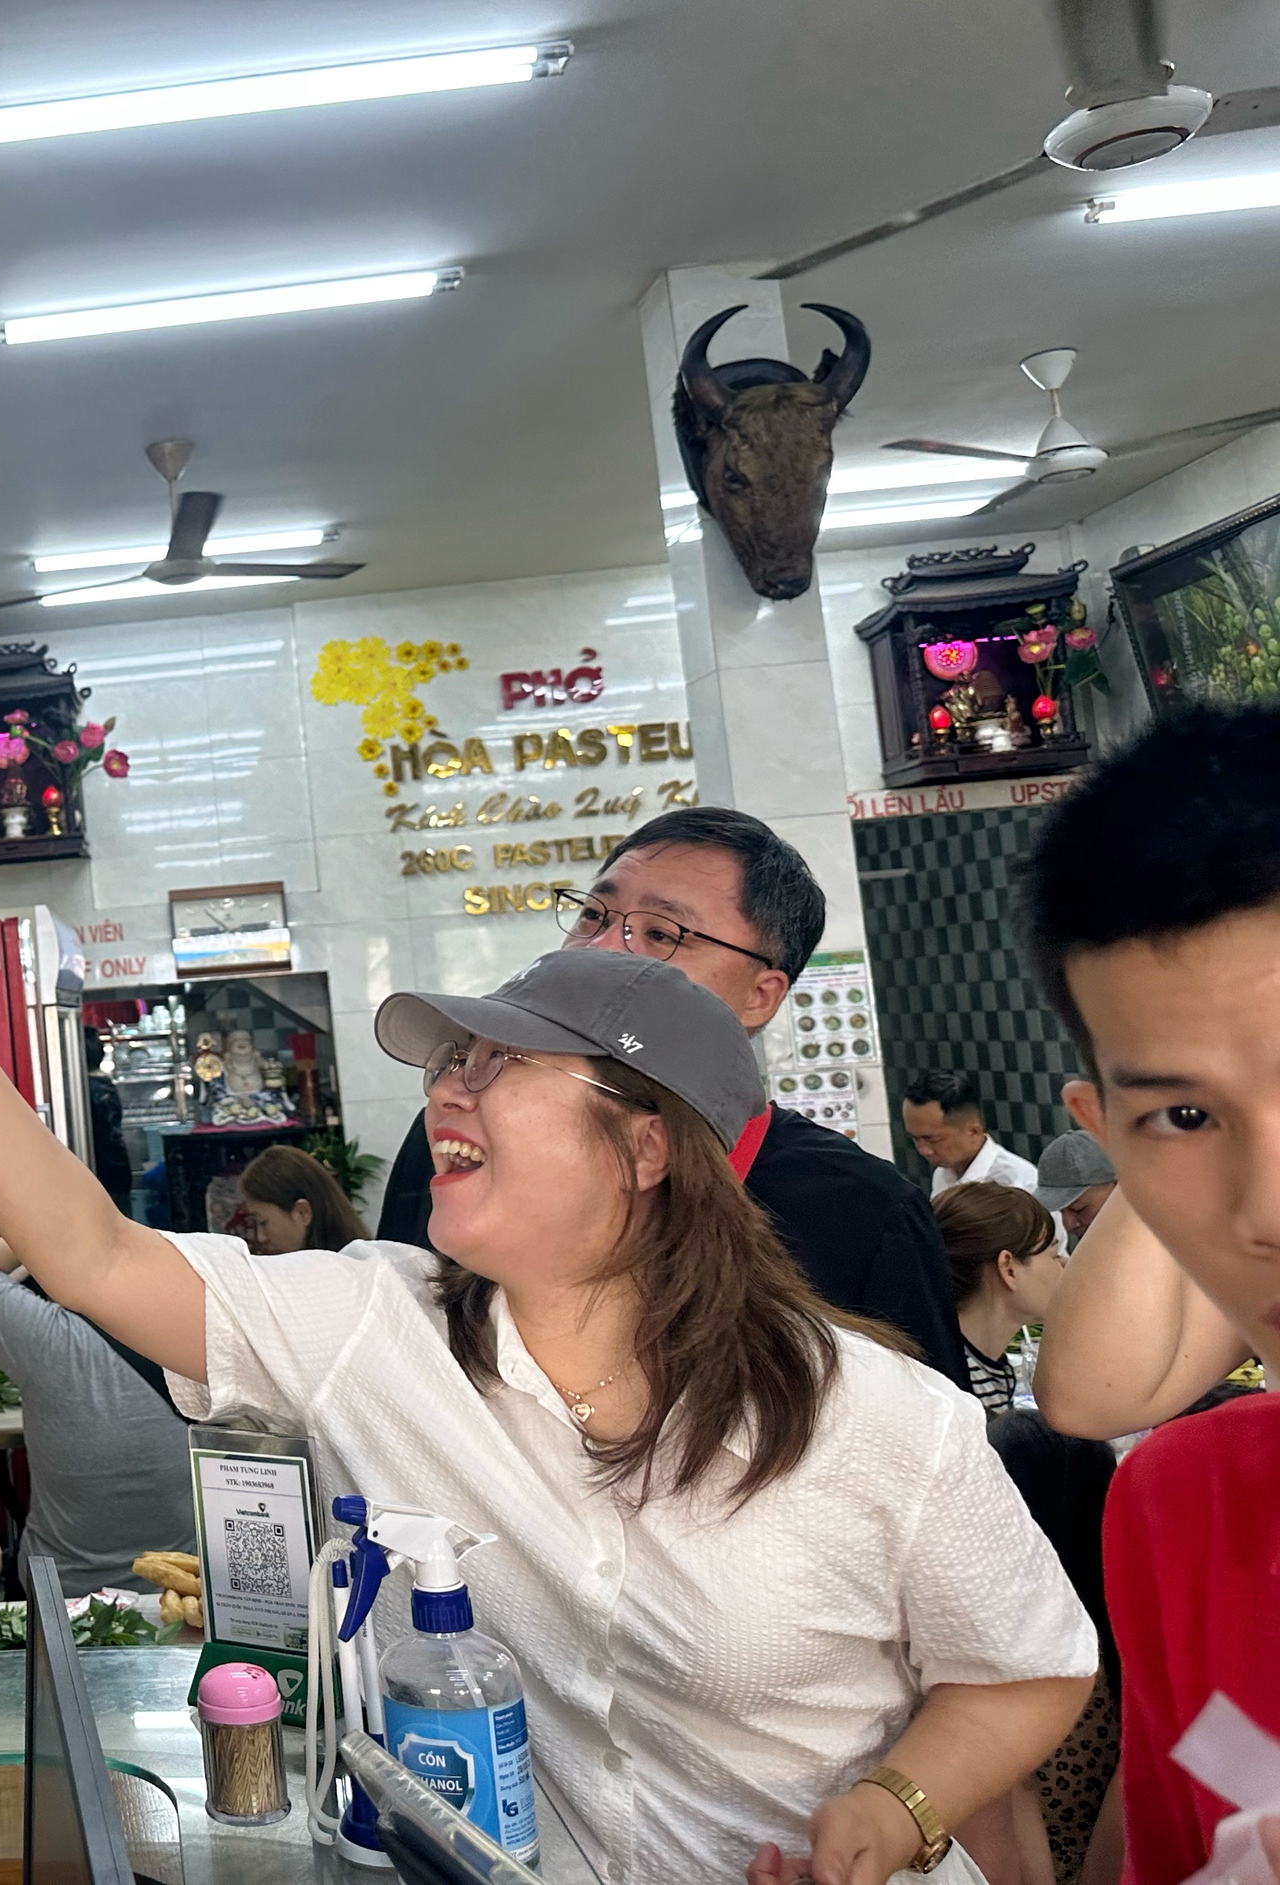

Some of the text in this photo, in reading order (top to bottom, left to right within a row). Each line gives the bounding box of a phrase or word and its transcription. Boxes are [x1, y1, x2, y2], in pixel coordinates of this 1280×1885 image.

[499, 646, 604, 711] PHỞ
[389, 721, 694, 782] HÒA PASTEU
[477, 791, 562, 824] Chào
[846, 781, 1070, 819] ỐI LÊN LẦU UPST
[401, 844, 473, 877] 260C
[88, 918, 125, 944] VIÊN
[100, 957, 147, 979] ONLY
[260, 1468, 277, 1476] LINH
[236, 1508, 270, 1518] Vietcombank
[420, 1776, 463, 1791] HANOL
